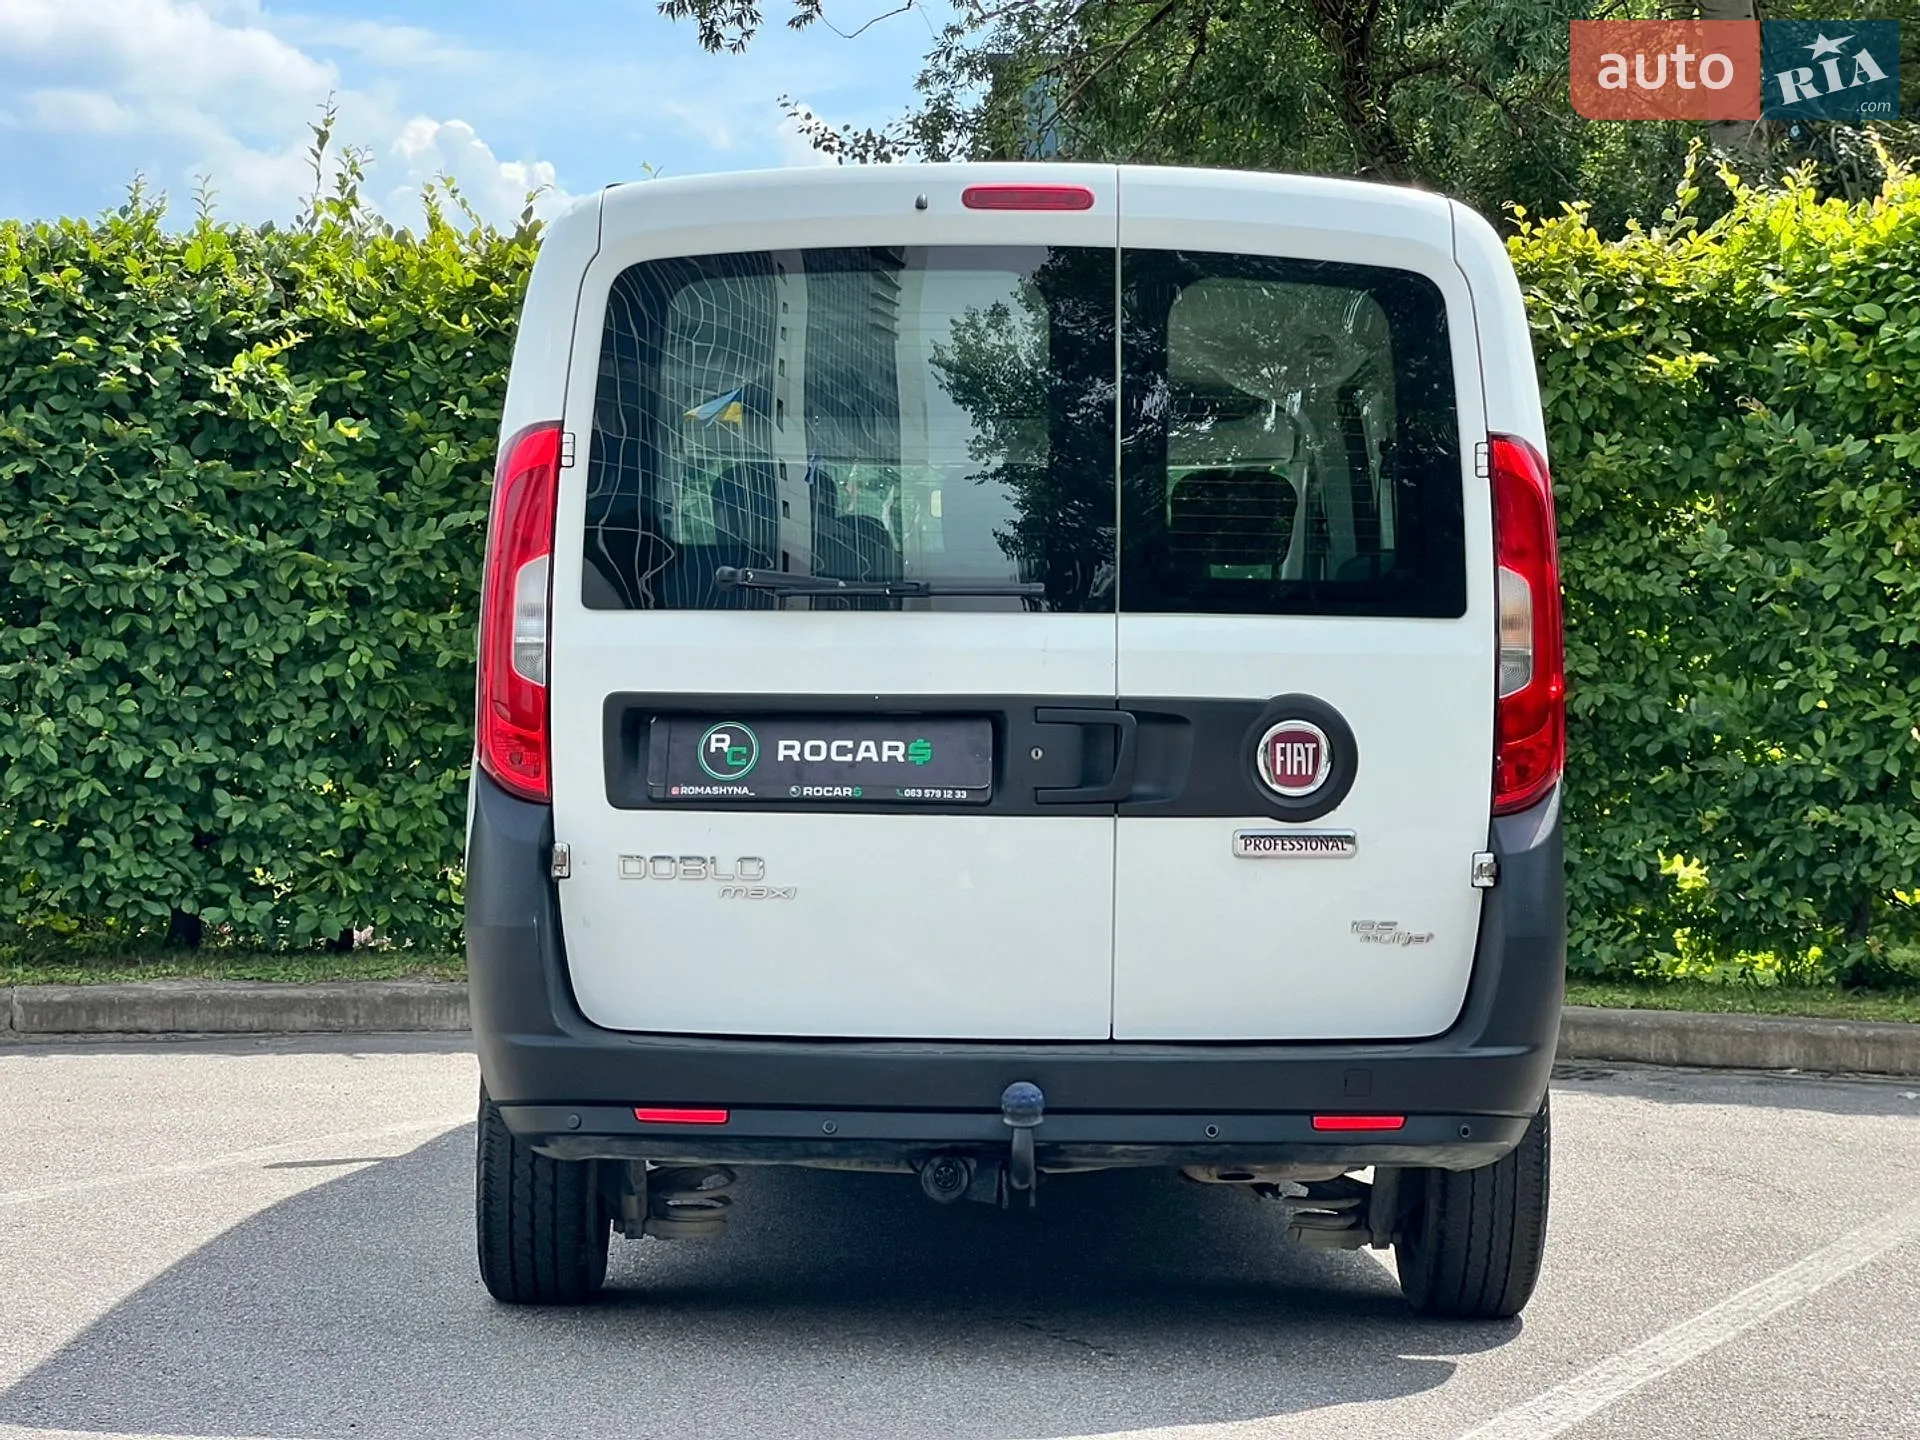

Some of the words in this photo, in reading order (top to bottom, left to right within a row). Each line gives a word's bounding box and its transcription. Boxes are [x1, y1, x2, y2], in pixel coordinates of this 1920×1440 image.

[1275, 742, 1317, 776] FIAT
[943, 790, 953, 799] 12
[1243, 837, 1348, 851] PROFESSIONAL
[618, 854, 766, 881] DOBLO
